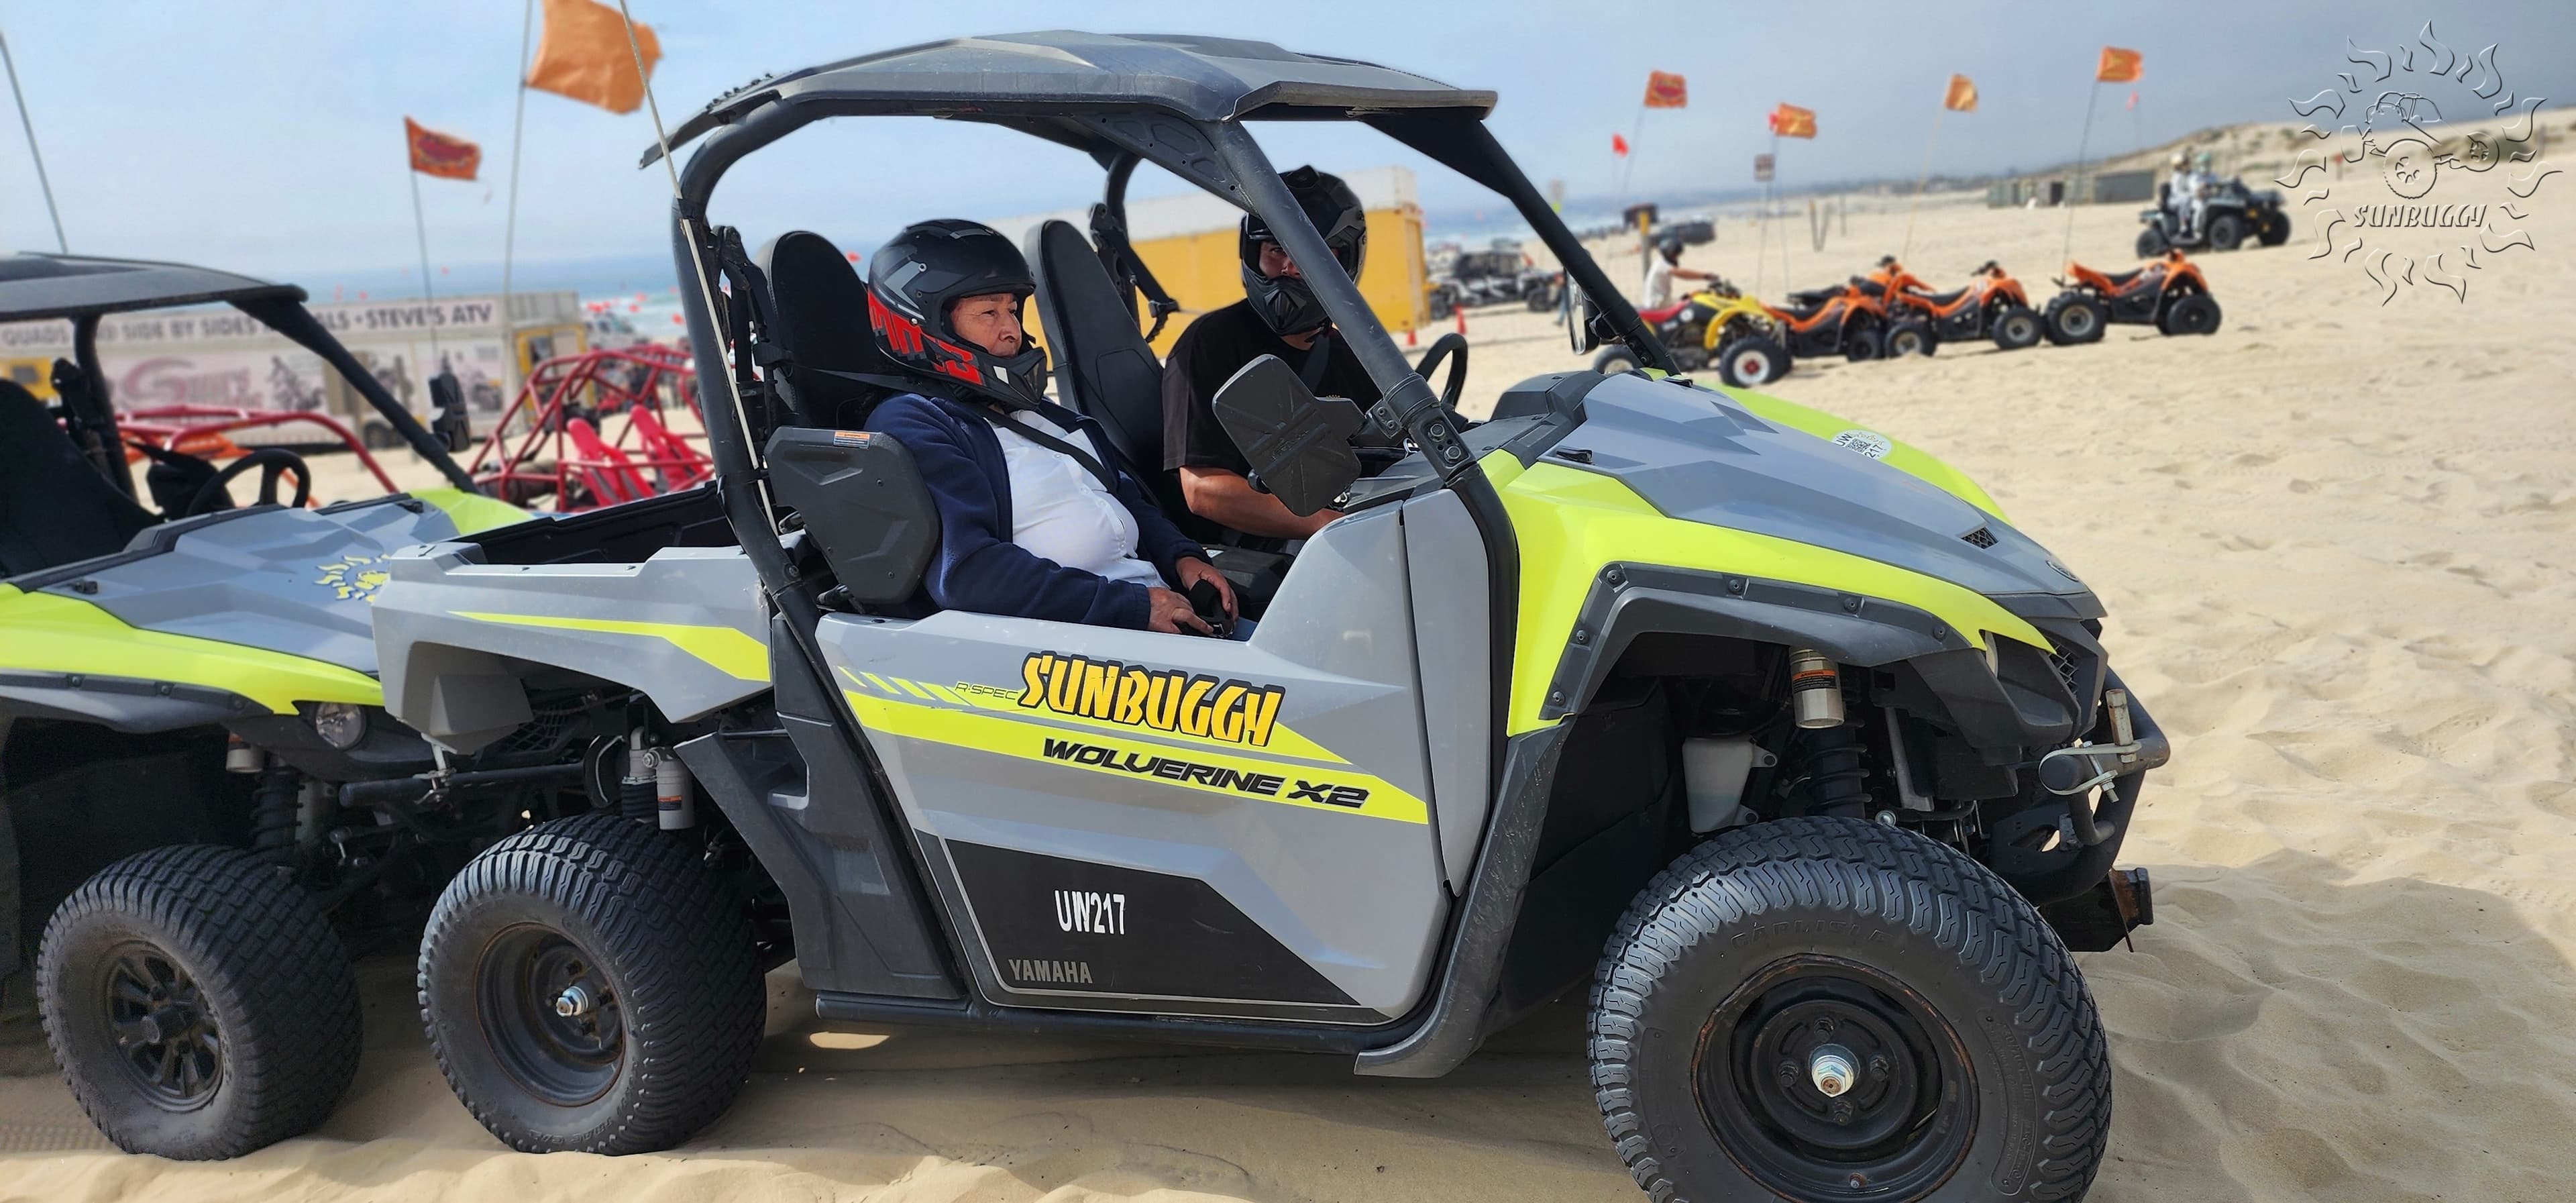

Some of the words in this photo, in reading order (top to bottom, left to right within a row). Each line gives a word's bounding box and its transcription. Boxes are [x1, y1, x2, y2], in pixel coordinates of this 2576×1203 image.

[364, 305, 445, 328] STEVE'S
[451, 303, 492, 323] ATV
[1835, 433, 1853, 447] UW
[1864, 443, 1884, 458] 217
[1018, 652, 1285, 747] SUNBUGGY
[1042, 737, 1287, 797] WOLVERINE
[1286, 779, 1371, 809] X2
[1055, 890, 1125, 935] UW217
[1008, 959, 1093, 984] YAMAHA
